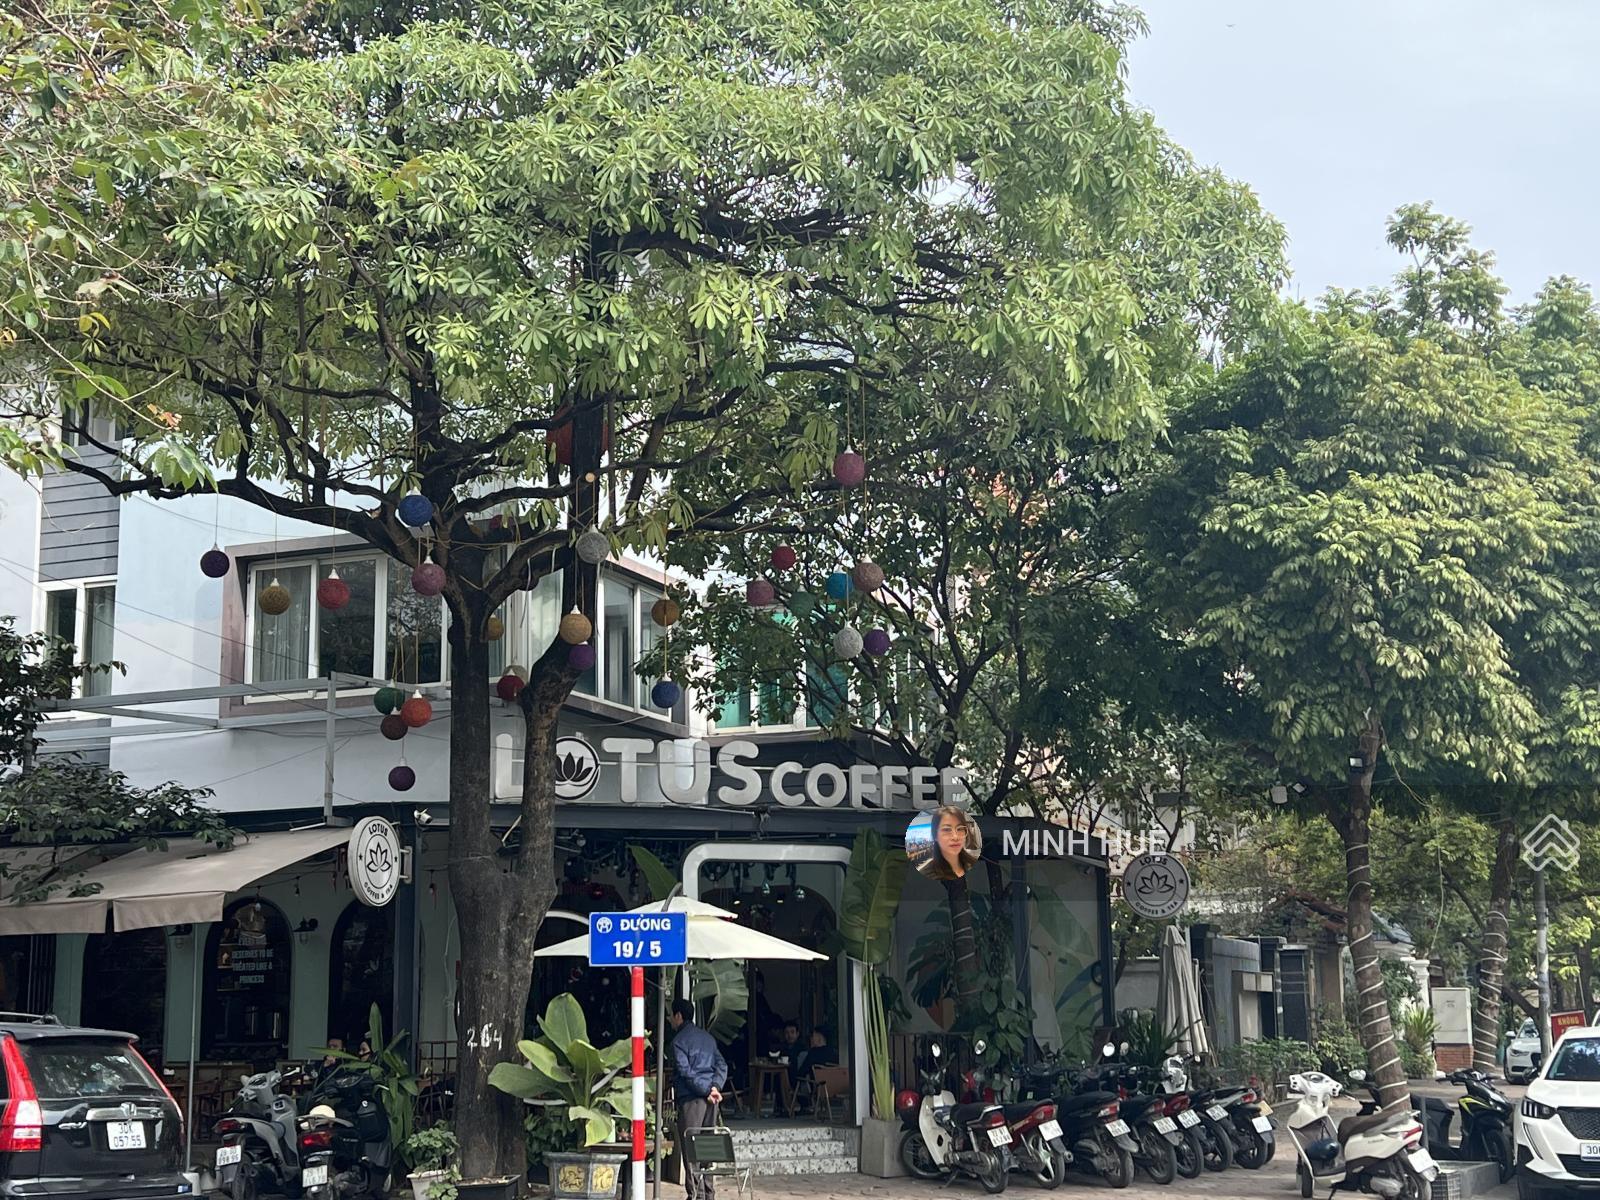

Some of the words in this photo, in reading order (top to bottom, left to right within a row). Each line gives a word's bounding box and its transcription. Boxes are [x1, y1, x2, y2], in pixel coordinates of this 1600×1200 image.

[770, 761, 969, 810] COFFEE
[368, 823, 388, 837] LOTUS
[1135, 901, 1159, 915] COFFEE
[620, 913, 672, 931] ĐƯỜNG
[1586, 1145, 1600, 1155] 30
